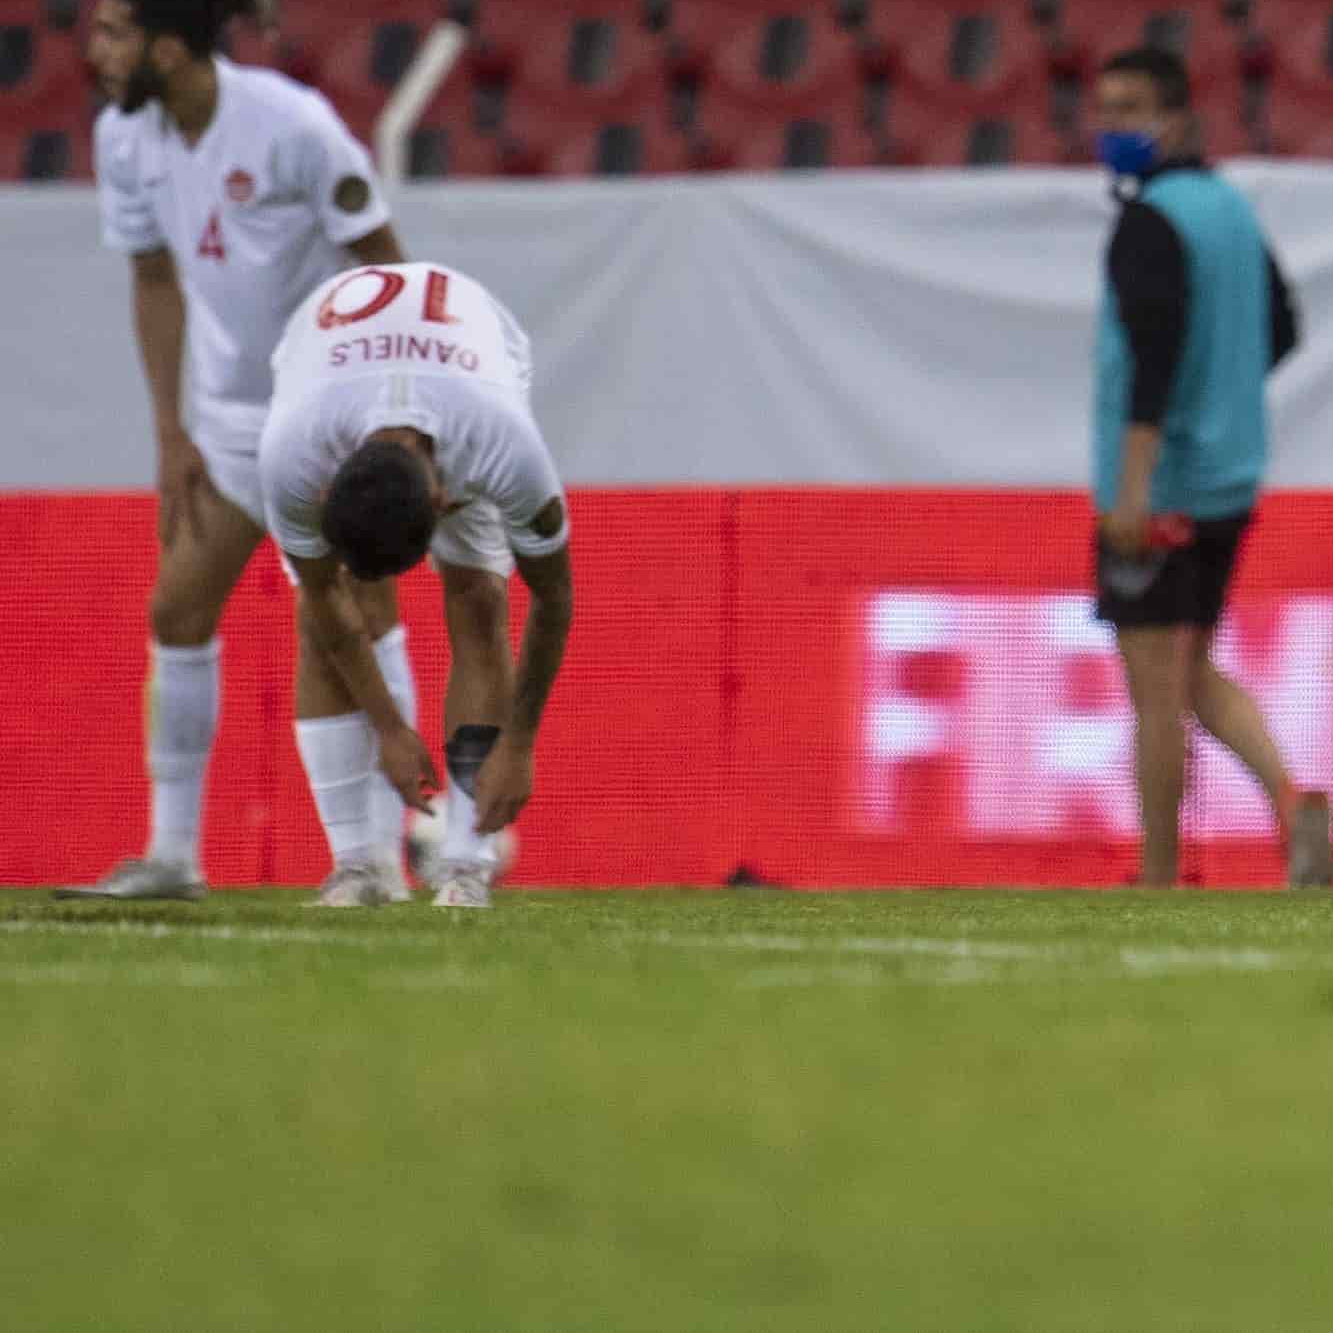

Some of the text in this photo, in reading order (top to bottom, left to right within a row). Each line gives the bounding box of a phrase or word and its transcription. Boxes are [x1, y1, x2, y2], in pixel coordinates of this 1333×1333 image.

[196, 212, 226, 263] 4
[316, 268, 463, 331] 10
[328, 333, 480, 372] DANIELS
